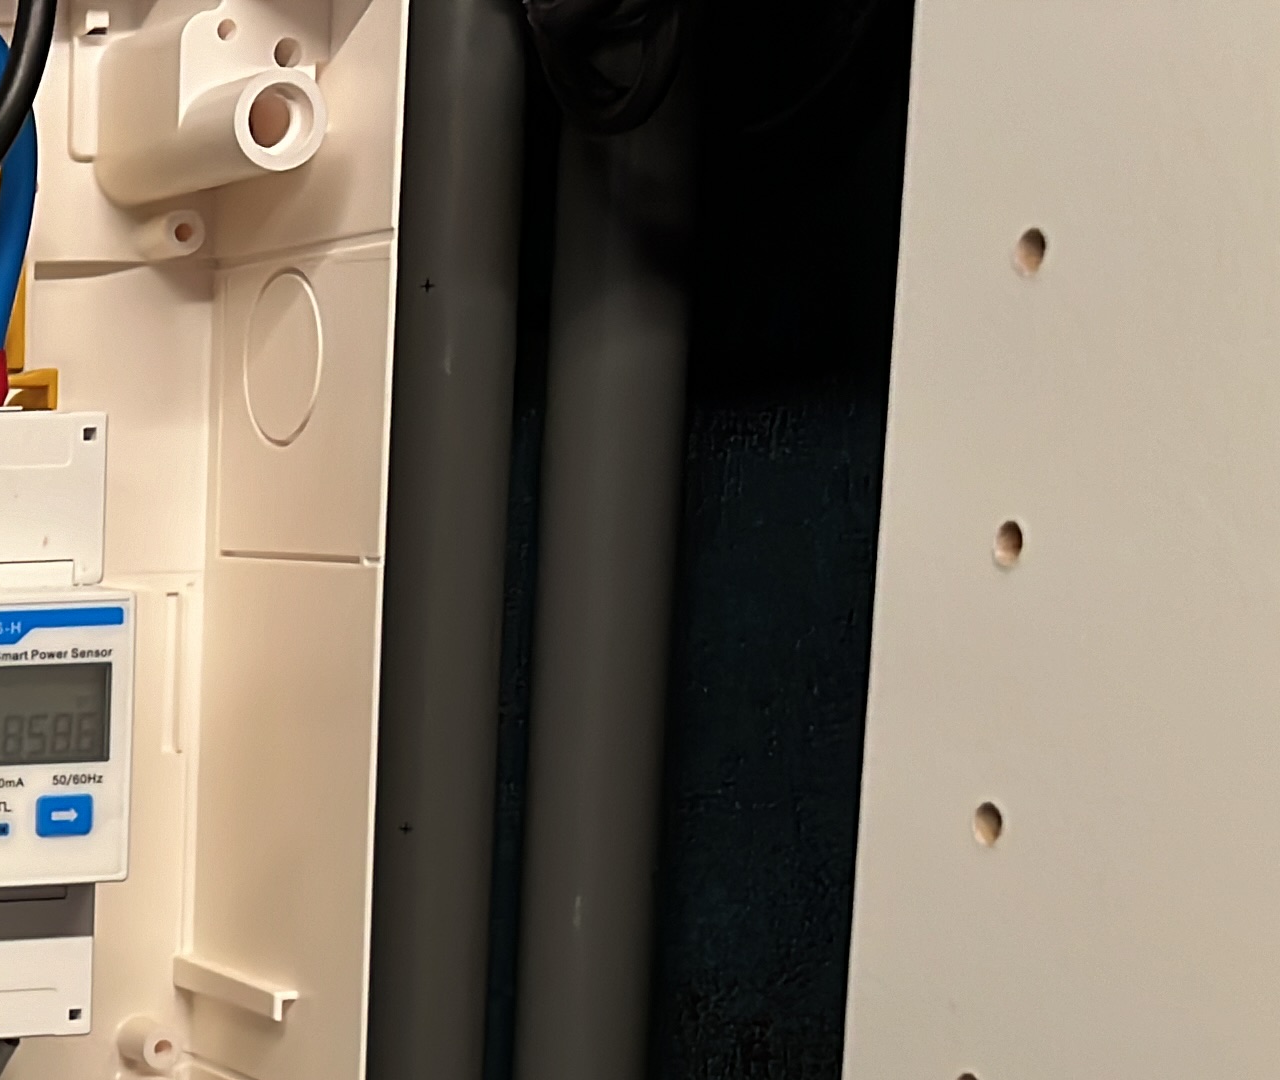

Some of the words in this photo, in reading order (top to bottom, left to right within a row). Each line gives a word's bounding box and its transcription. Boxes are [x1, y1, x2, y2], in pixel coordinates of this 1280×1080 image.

[30, 649, 68, 661] Power
[71, 648, 113, 659] Sensor
[52, 774, 104, 786] 50/60Hz
